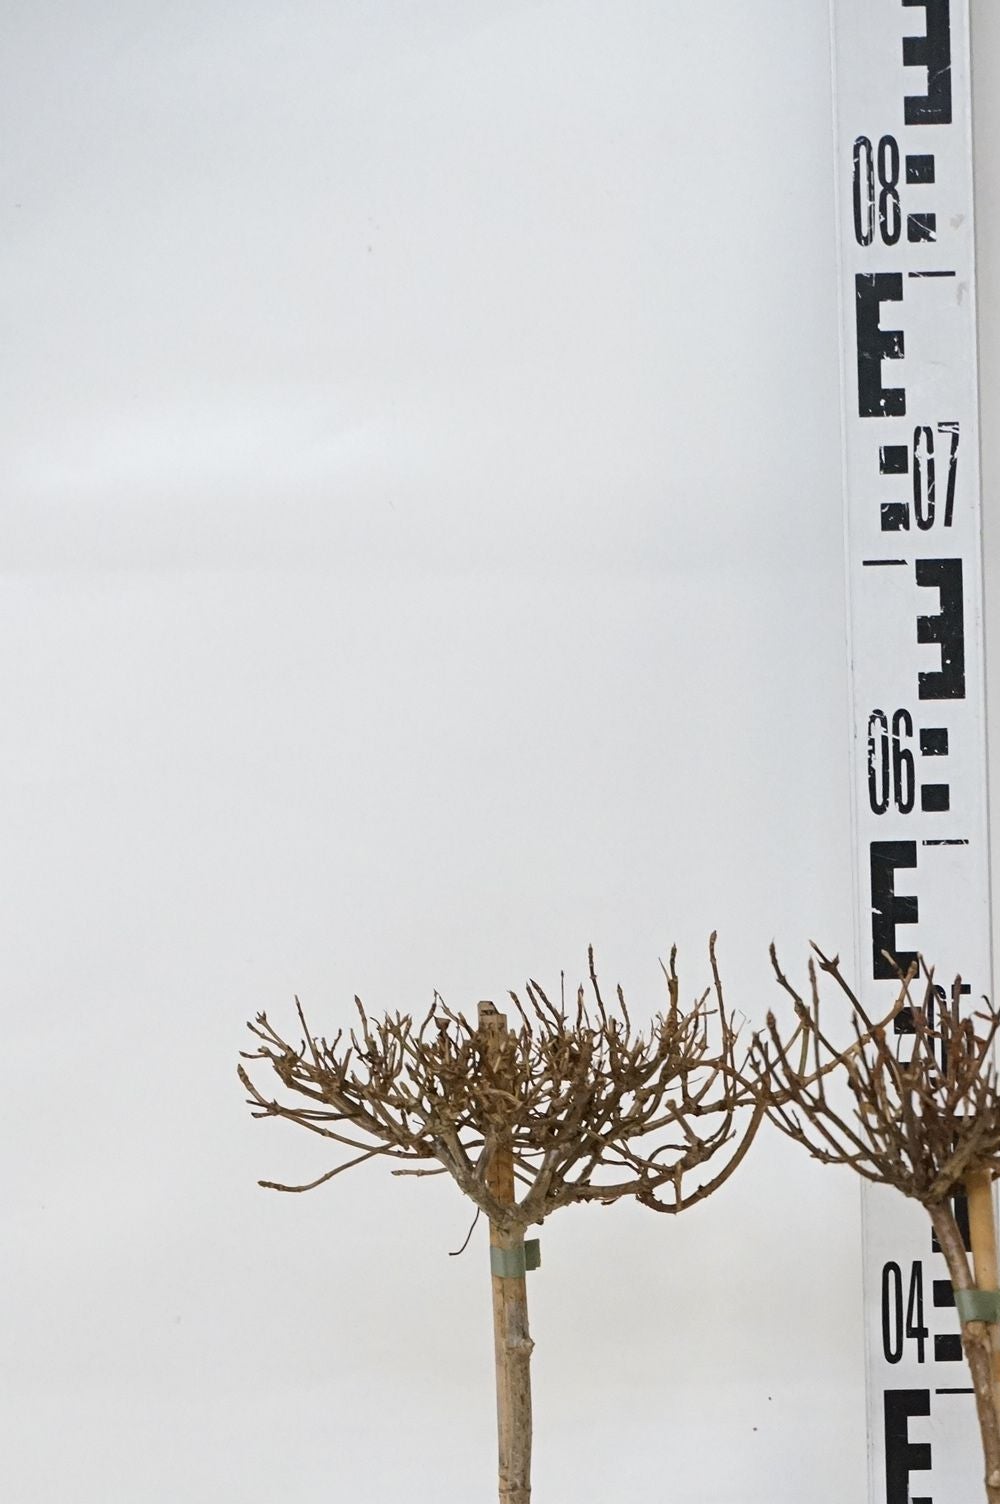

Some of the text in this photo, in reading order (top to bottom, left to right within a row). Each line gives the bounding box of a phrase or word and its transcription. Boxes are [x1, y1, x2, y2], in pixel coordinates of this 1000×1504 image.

[853, 134, 901, 247] 08
[913, 421, 960, 531] 07
[867, 708, 915, 815] 06
[881, 1260, 929, 1364] 04
